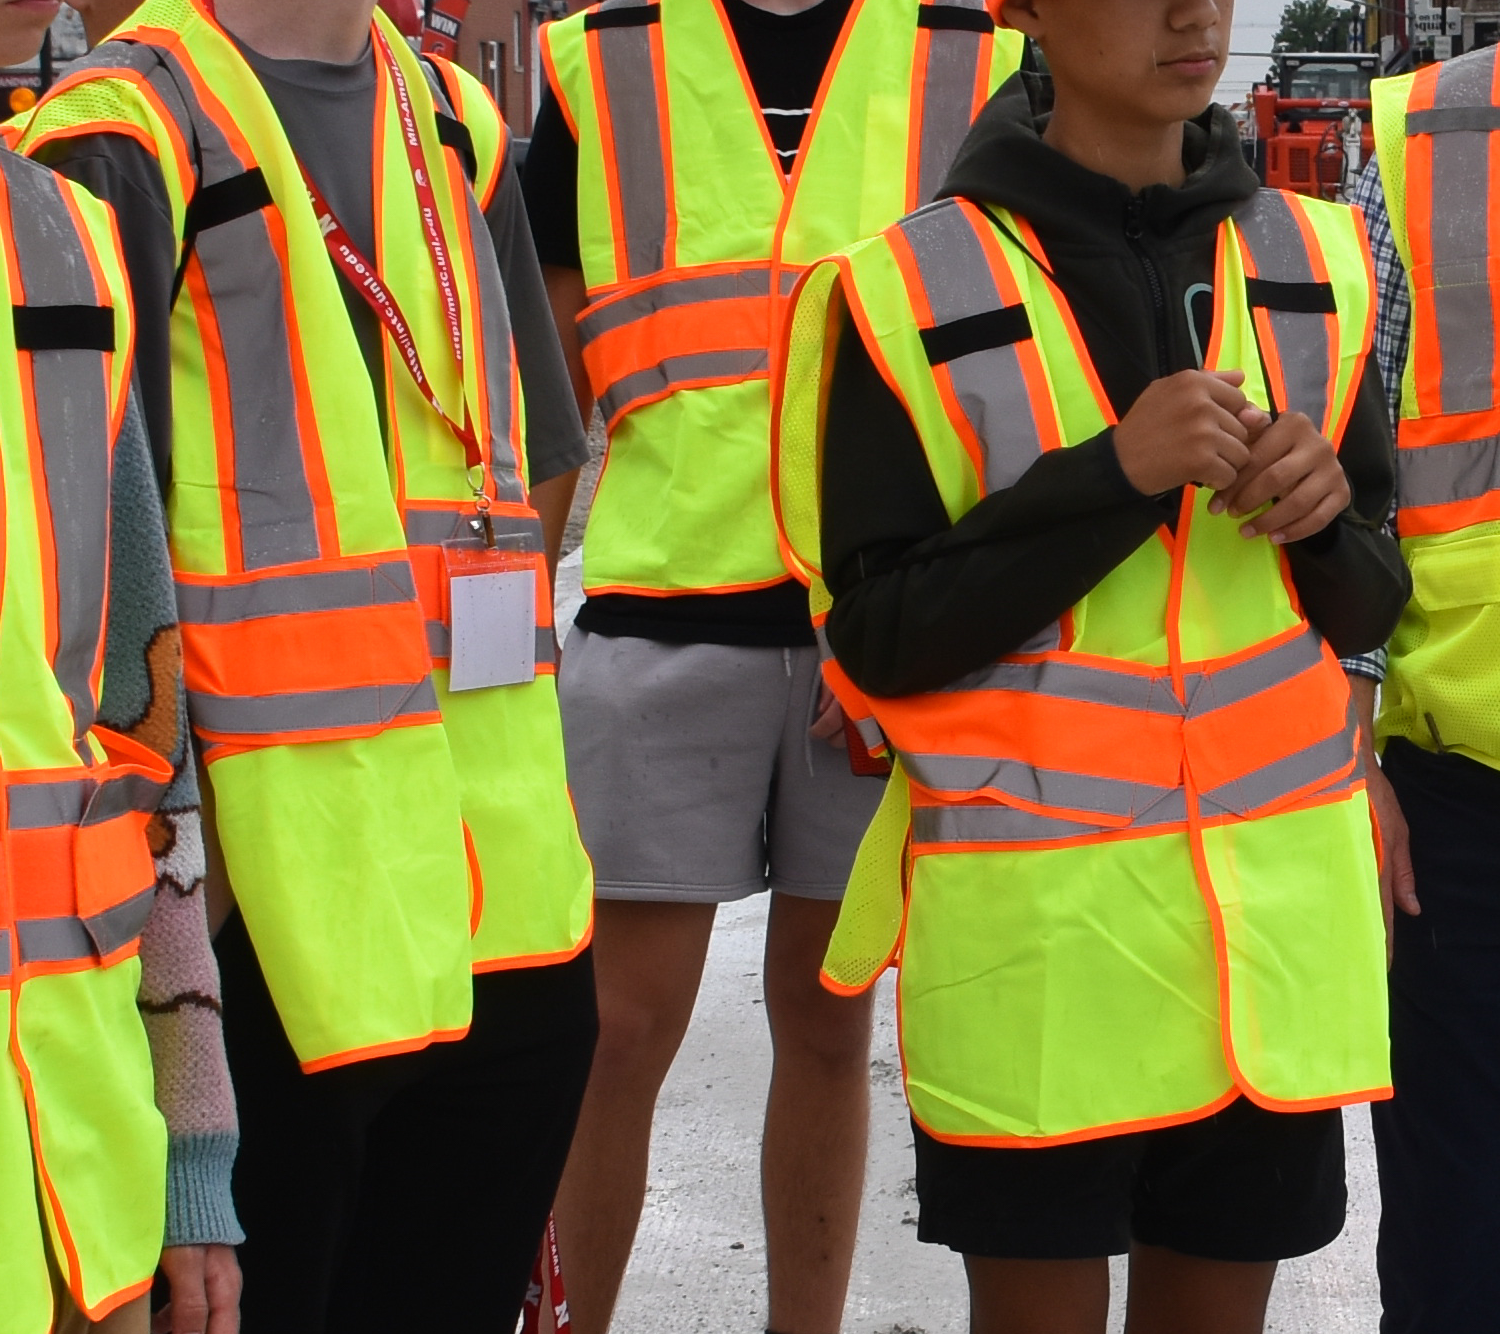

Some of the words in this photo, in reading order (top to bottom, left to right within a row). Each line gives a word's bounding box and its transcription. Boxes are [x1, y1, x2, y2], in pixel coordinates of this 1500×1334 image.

[1419, 14, 1430, 22] on
[1432, 12, 1442, 21] th
[431, 12, 458, 37] WIN
[1414, 21, 1456, 32] squae
